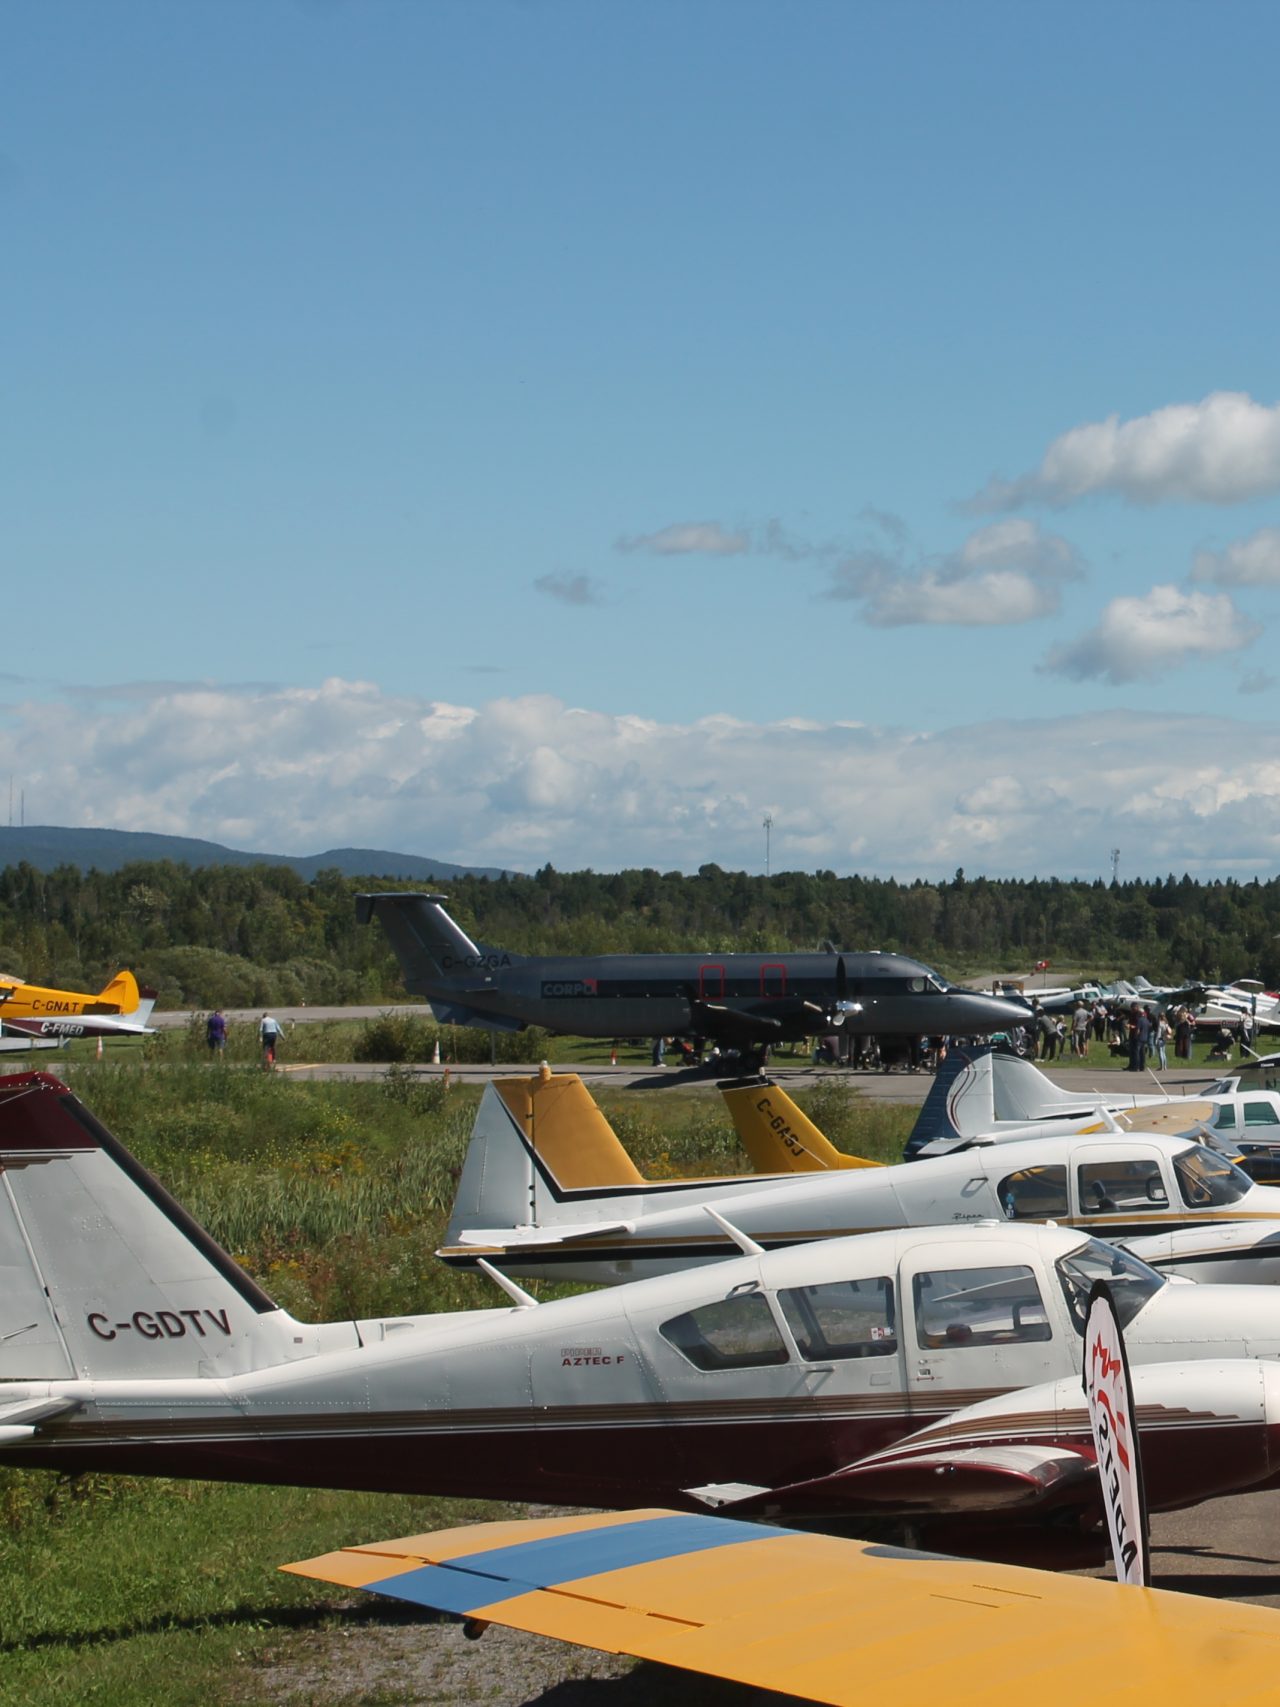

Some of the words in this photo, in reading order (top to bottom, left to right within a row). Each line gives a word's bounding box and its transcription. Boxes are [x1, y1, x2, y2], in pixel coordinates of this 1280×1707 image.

[32, 1000, 79, 1013] C-GNAT
[88, 1309, 232, 1340] C-GDTV
[562, 1356, 611, 1366] AZTEC
[616, 1356, 625, 1364] F
